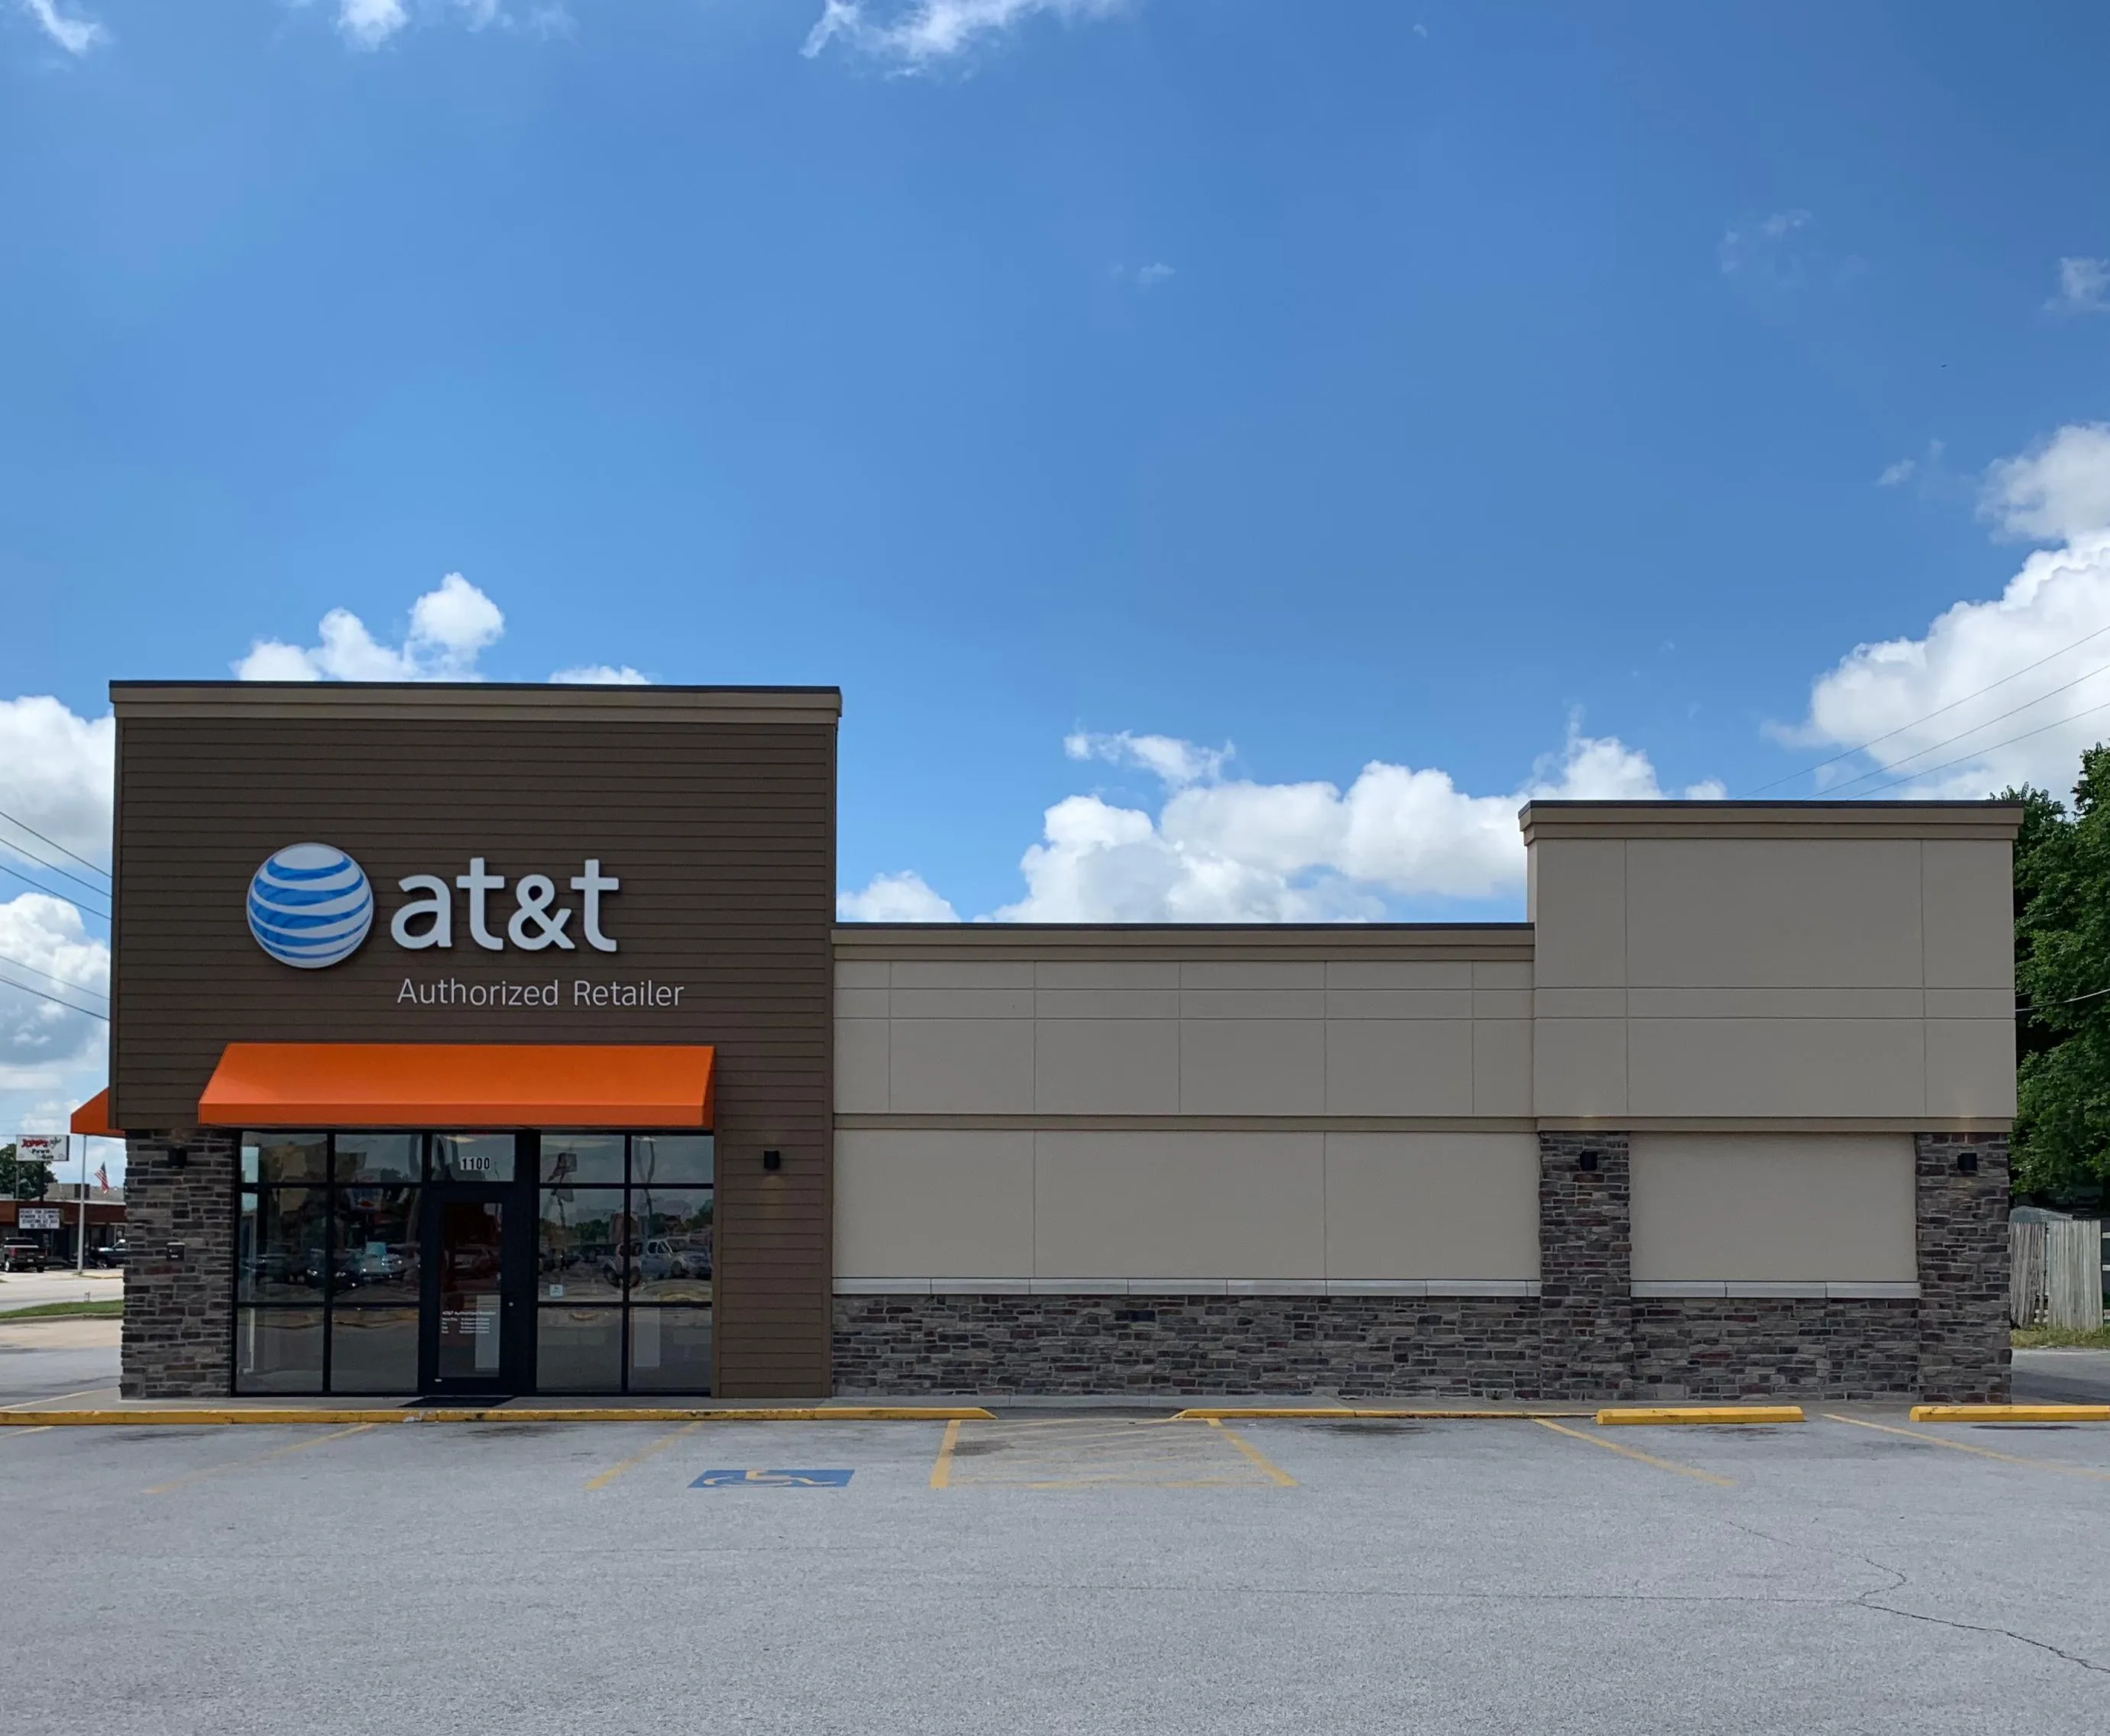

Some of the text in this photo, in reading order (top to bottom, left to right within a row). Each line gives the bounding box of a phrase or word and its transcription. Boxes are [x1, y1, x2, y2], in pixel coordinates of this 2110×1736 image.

[390, 857, 619, 952] at&t
[396, 978, 684, 1007] Authorized Retailer
[462, 1158, 490, 1169] 1100
